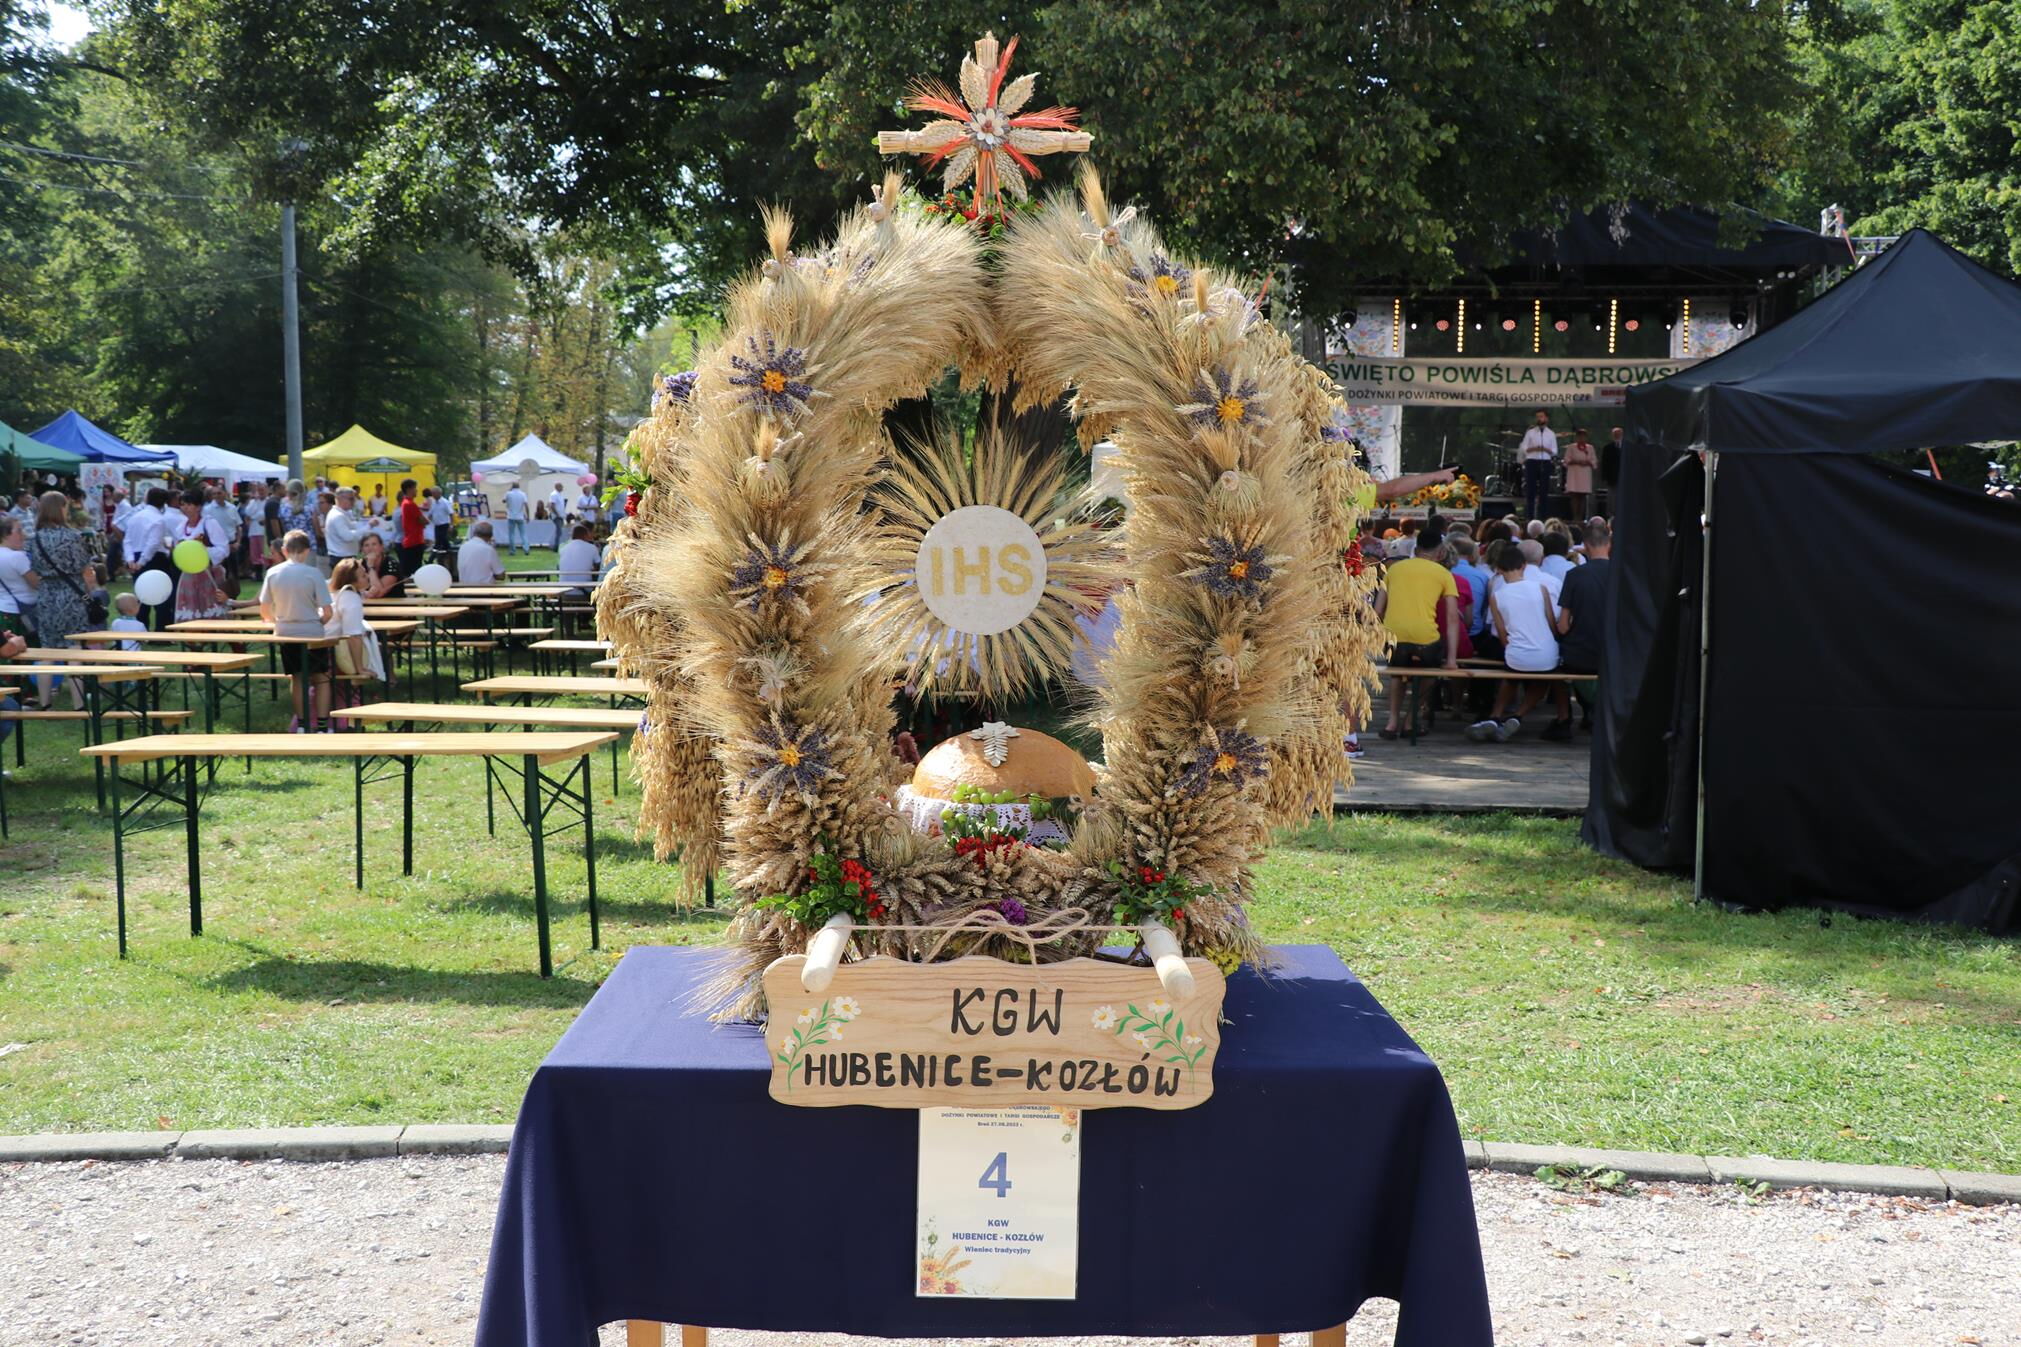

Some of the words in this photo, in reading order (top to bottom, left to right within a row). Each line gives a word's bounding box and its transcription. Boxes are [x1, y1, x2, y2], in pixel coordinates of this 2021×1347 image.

[1327, 359, 1415, 385] ŚWIĘTO
[1427, 363, 1536, 384] POWIŚLA
[1547, 367, 1680, 388] DĄBROWS
[1348, 389, 1395, 400] DOŻYNKI
[1399, 390, 1466, 400] POWIATOWE
[1477, 392, 1508, 402] TARGI
[1511, 392, 1593, 402] GOSPODARCZE
[930, 543, 1033, 597] IHS
[951, 988, 1064, 1036] KGW
[979, 1152, 1012, 1198] 4
[987, 1219, 1009, 1227] KGW
[952, 1232, 998, 1241] HUBENICE
[1005, 1232, 1045, 1241] KOZŁÓW
[994, 1247, 1031, 1255] tradycyjny
